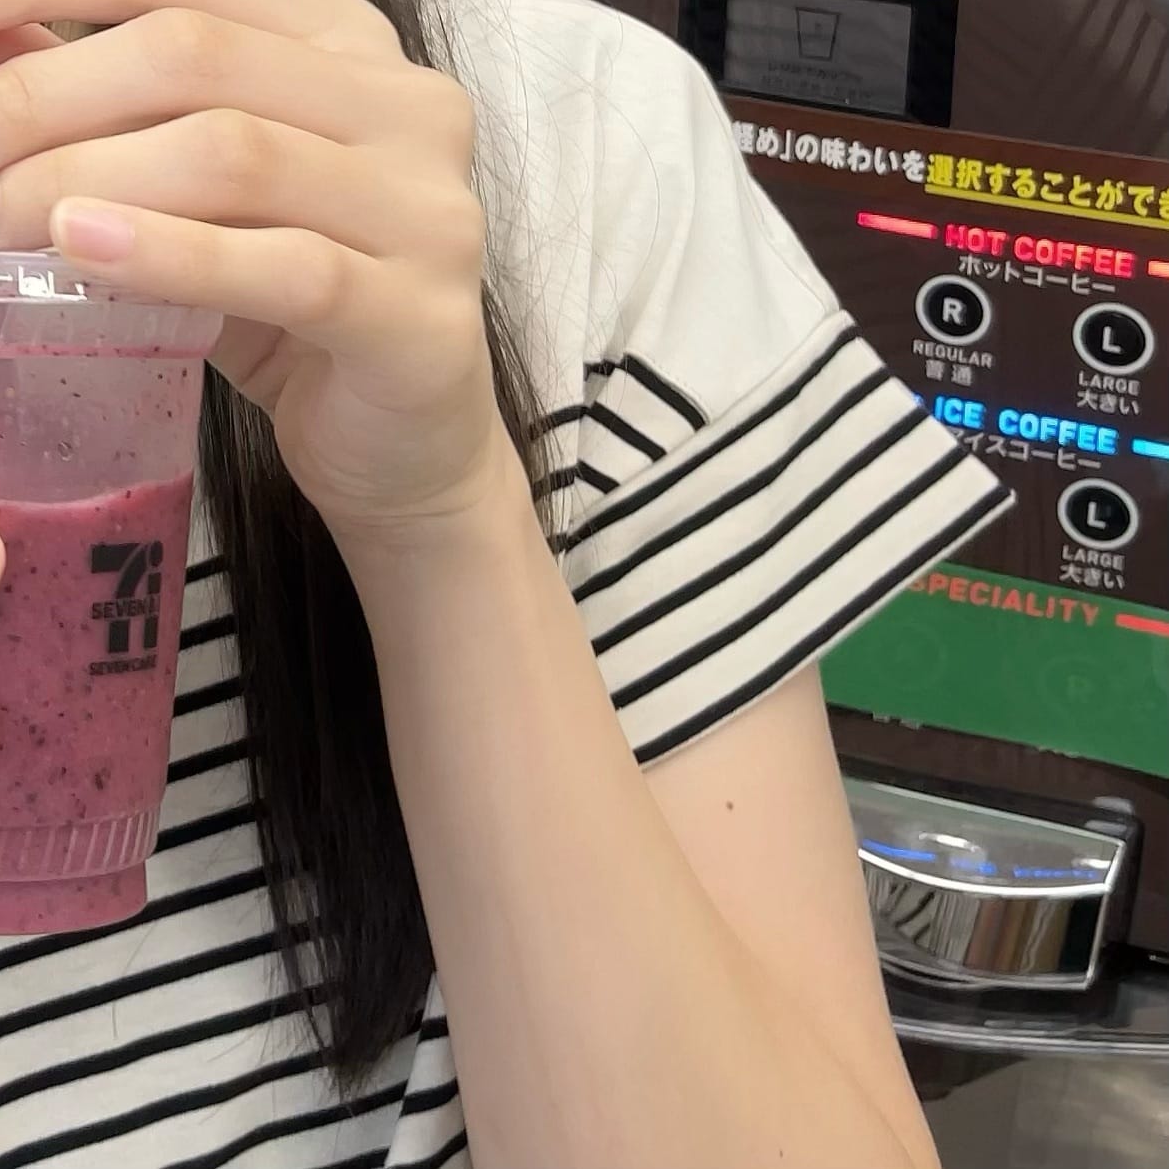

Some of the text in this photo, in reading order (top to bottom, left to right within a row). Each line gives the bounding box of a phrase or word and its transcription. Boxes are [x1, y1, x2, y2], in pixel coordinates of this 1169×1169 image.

[944, 224, 1136, 278] HOT COFFEE
[958, 253, 1116, 296] ホットコーヒー
[942, 296, 966, 325] R
[912, 339, 994, 369] REGULAR
[1102, 325, 1122, 354] L
[1078, 372, 1141, 397] LARGE
[1076, 390, 1141, 415] 大きい
[934, 395, 1119, 456] ICE COFFEE
[1087, 501, 1107, 530] L
[1061, 545, 1126, 571] LARGE
[1059, 563, 1126, 590] 大きい
